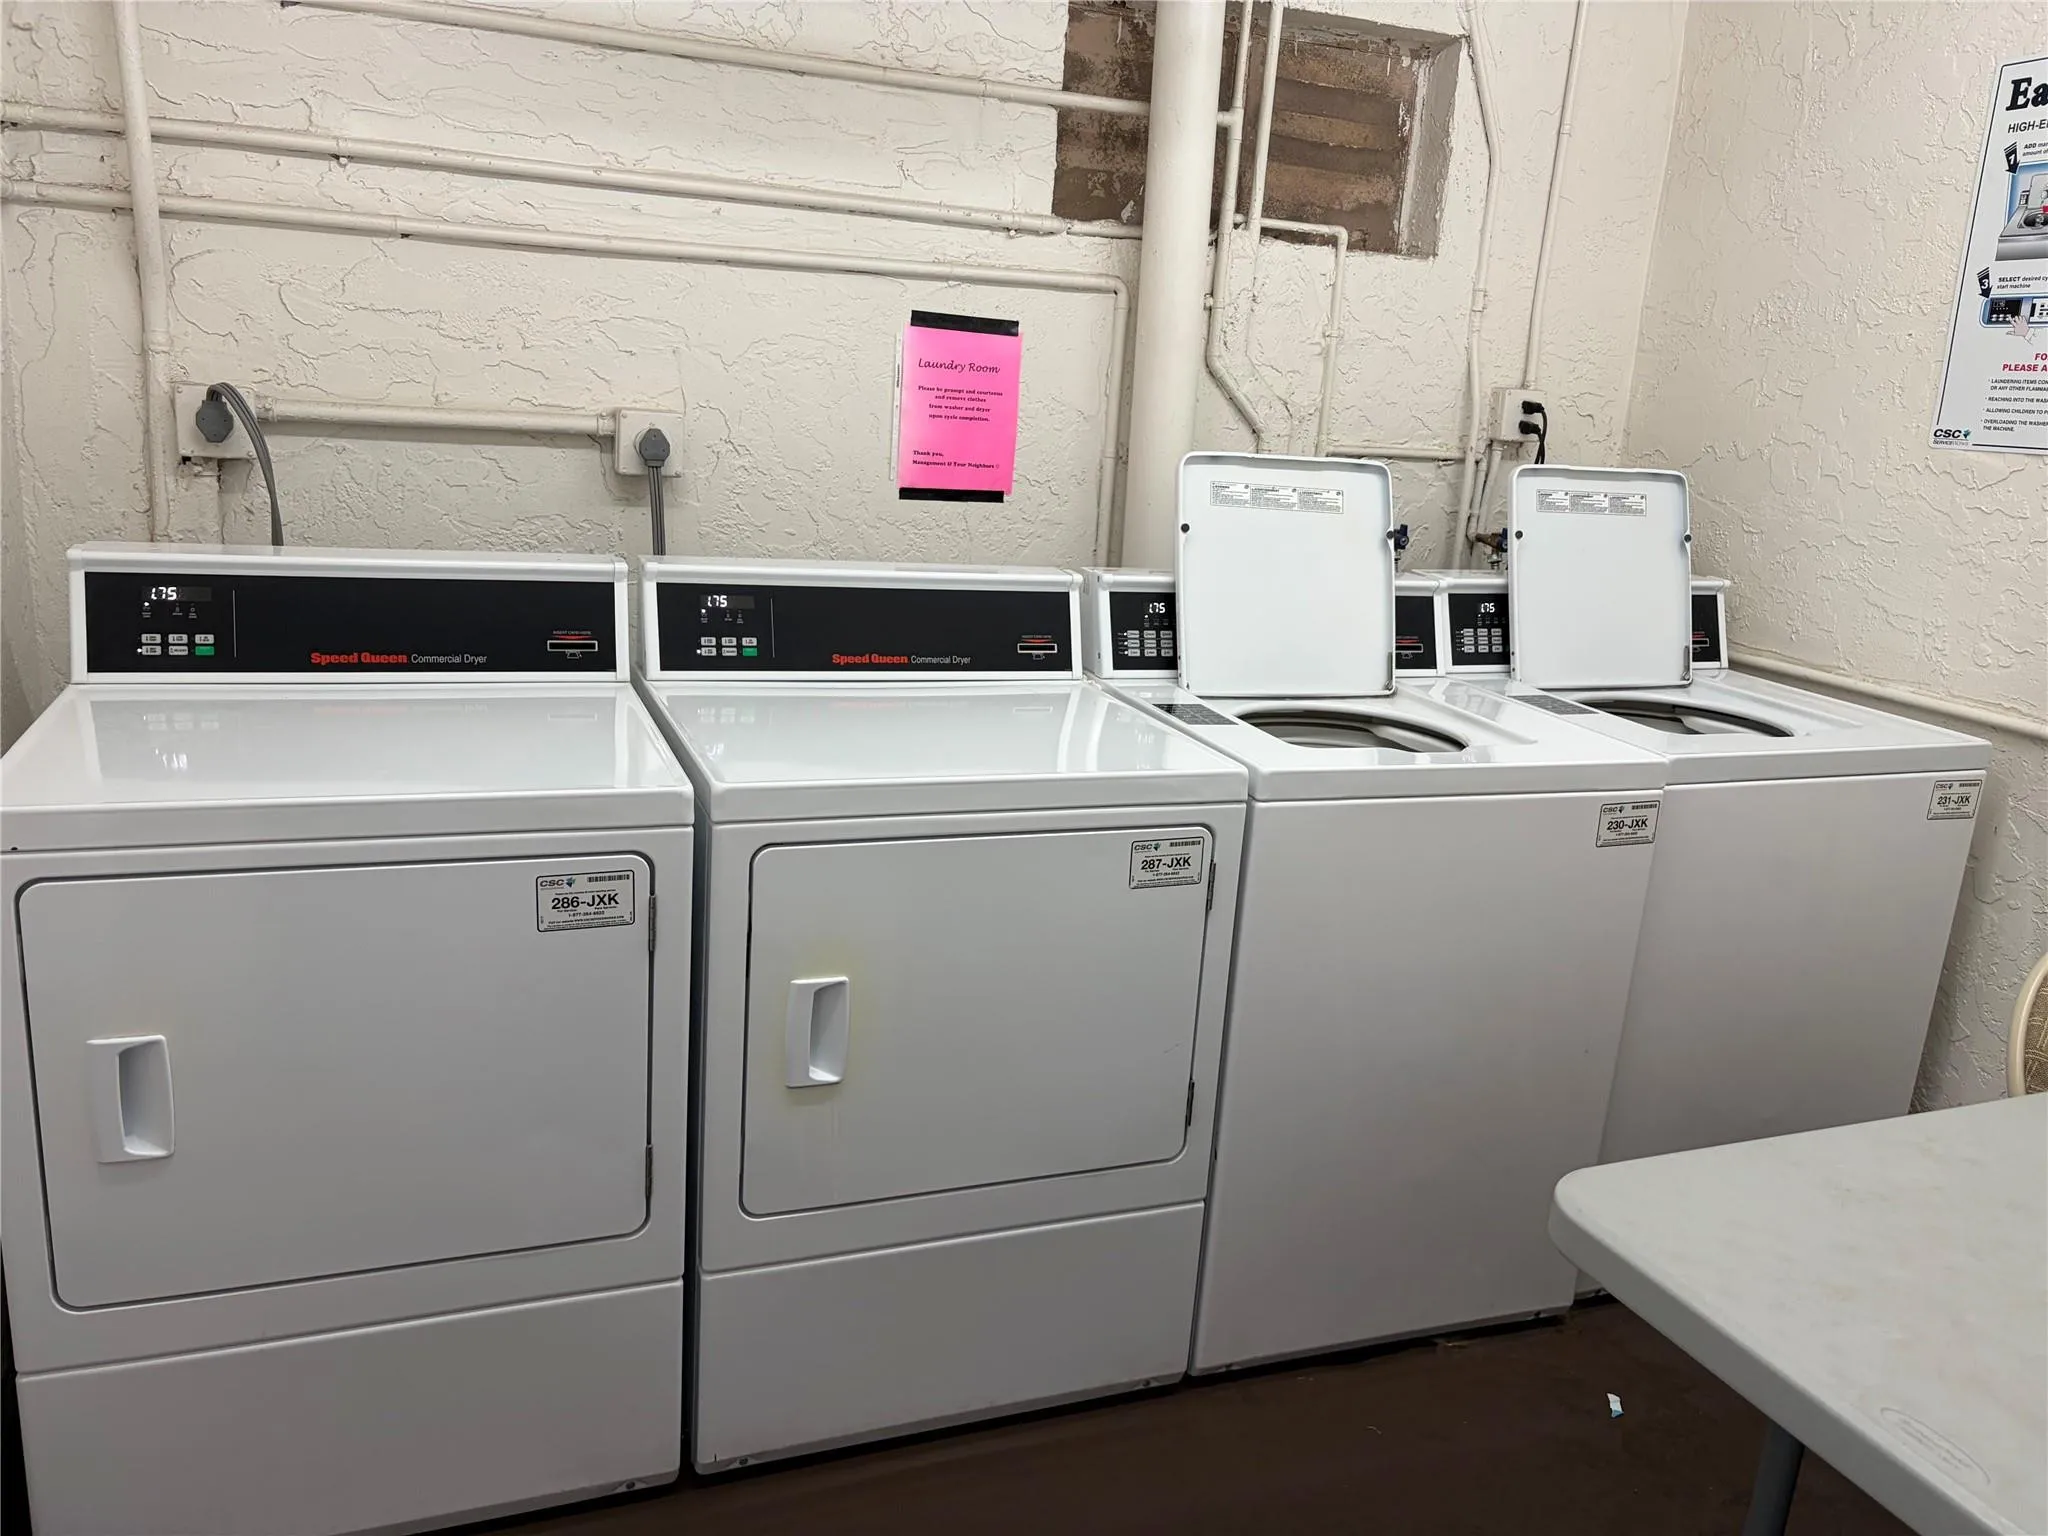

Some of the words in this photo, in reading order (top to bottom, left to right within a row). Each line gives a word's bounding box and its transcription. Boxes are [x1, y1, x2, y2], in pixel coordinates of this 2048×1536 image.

[2008, 119, 2048, 133] HIGH-E
[1981, 279, 1988, 289] 3
[918, 358, 966, 373] Laundry
[968, 362, 1001, 374] Room
[2002, 363, 2040, 372] PLEASE
[1933, 428, 1962, 439] CSC
[310, 652, 359, 666] Speed
[360, 652, 408, 664] Queen
[411, 653, 462, 664] Commercial
[464, 653, 488, 665] Dryer
[832, 653, 869, 666] Speed
[871, 653, 908, 664] Queen
[910, 655, 951, 664] Commercial
[952, 655, 971, 666] Dryer
[1936, 795, 1971, 805] 231-JXK
[1607, 818, 1648, 830] 230-JXK
[1141, 856, 1191, 870] 287-JXK
[540, 879, 564, 887] CSC
[552, 893, 619, 909] 286-JXK
